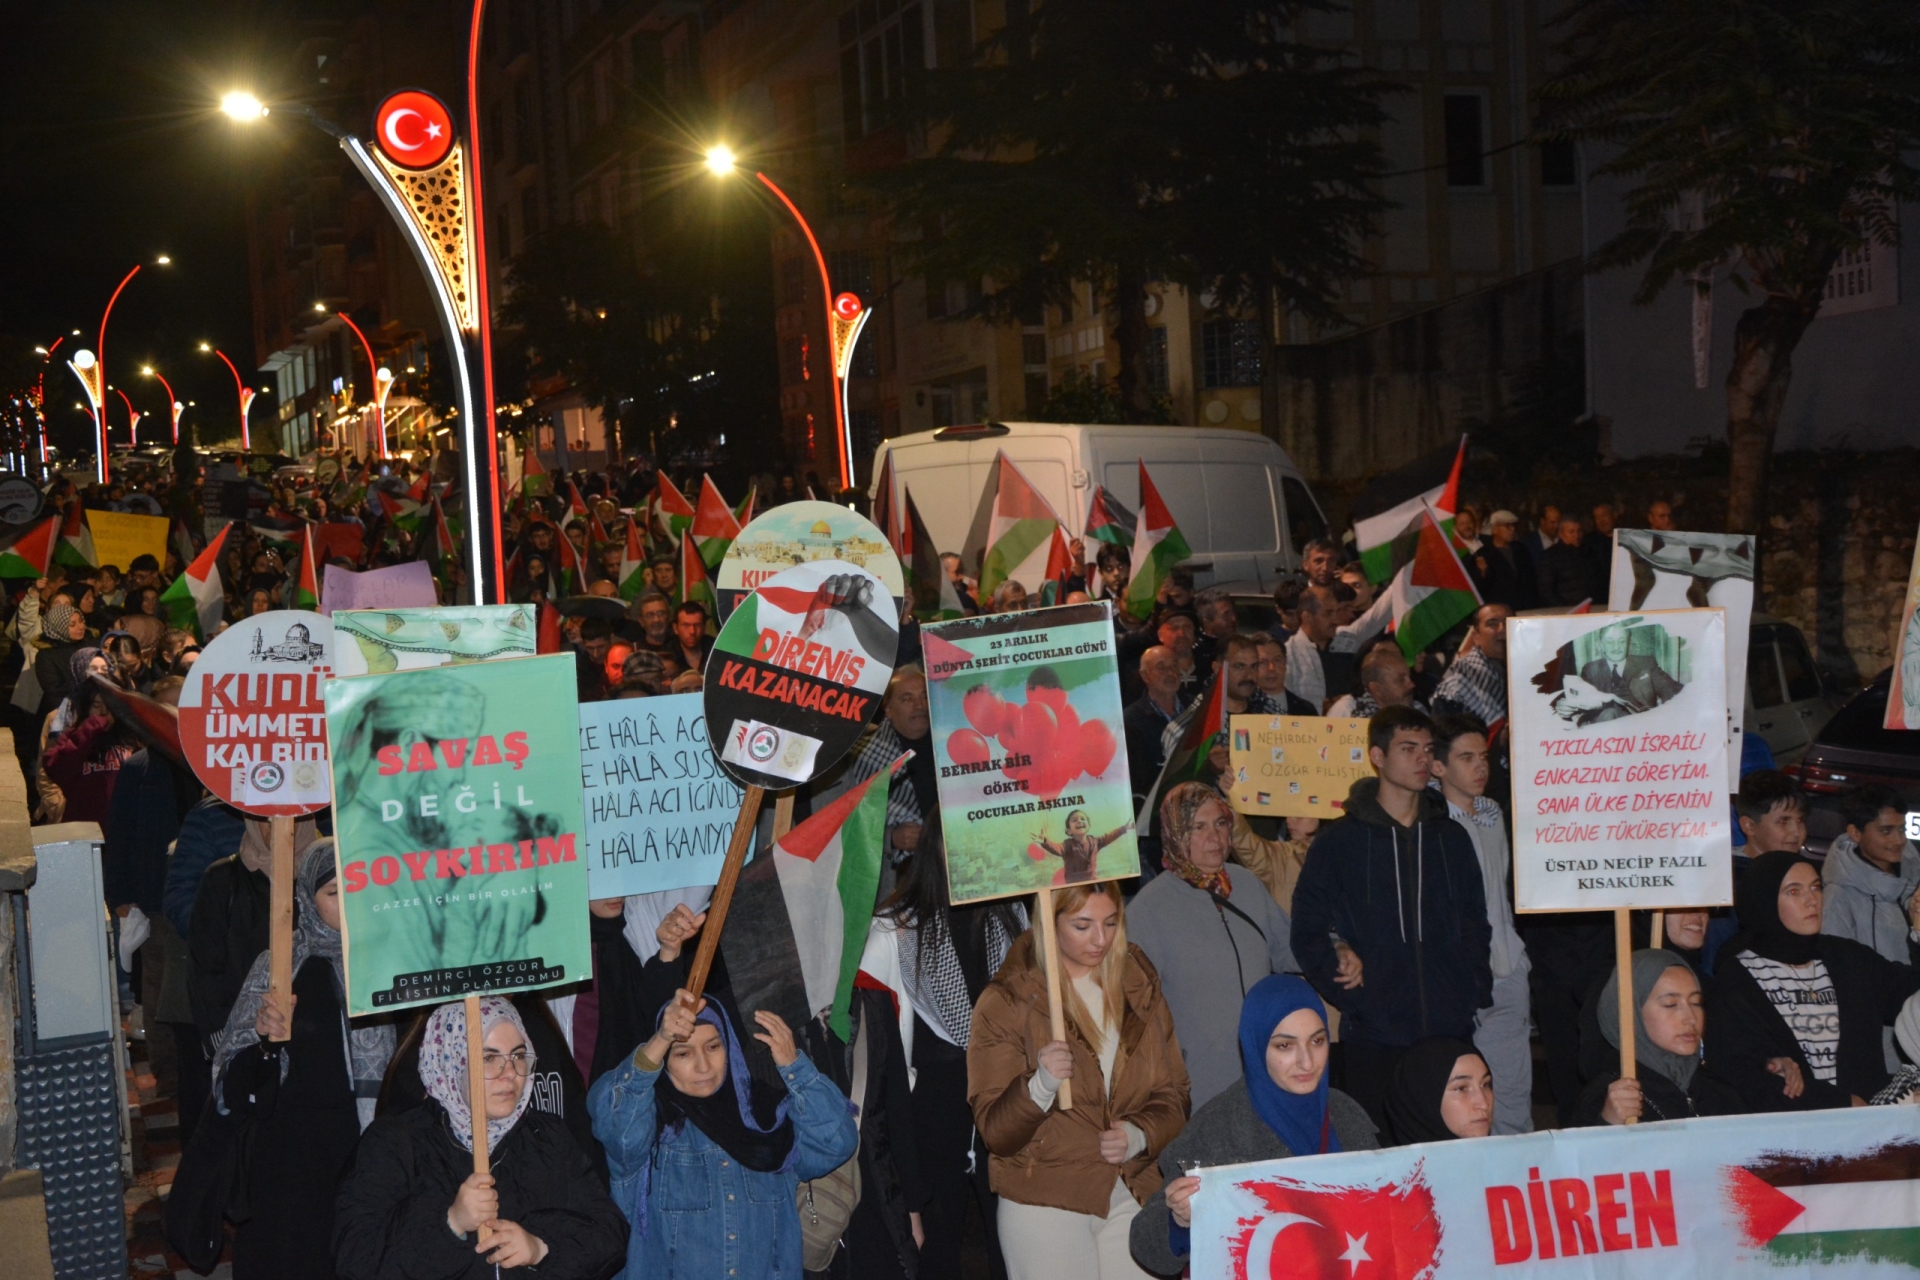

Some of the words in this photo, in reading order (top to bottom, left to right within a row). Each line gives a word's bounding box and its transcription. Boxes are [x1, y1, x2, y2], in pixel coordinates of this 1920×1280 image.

[990, 641, 1003, 650] 23
[1004, 633, 1048, 648] ARALIK
[751, 627, 865, 688] DİRENİŞ
[933, 659, 973, 674] DÜNYA
[976, 653, 1010, 669] ŞEHİT
[1013, 646, 1073, 665] ÇOCUKLAR
[1075, 640, 1108, 654] GÜNÜ
[719, 660, 869, 722] KAZANACAK
[609, 712, 665, 748] HÂLÂ
[1257, 730, 1318, 744] NEHİRDEN
[1638, 730, 1706, 753] İSRAİL!
[376, 731, 530, 776] SAVAŞ
[603, 750, 668, 786] HÂLÂ
[941, 759, 1002, 778] BERRAK
[1005, 752, 1032, 769] BİR
[983, 779, 1029, 796] GÖKTE
[1534, 766, 1623, 786] ENKAZINI
[1625, 760, 1710, 783] GÖREYİM.
[381, 781, 534, 822] DEĞİL
[592, 789, 643, 823] HÂLÂ
[967, 803, 1035, 823] ÇOCUKLAR
[1037, 795, 1085, 811] AŞKINA
[1537, 796, 1580, 815] SANA
[1584, 792, 1629, 813] ÜLKE
[1632, 788, 1713, 811] DİYENİN
[601, 826, 660, 868] HÂLÂ
[1535, 821, 1601, 844] YÜZÜNE
[343, 833, 578, 894] SOYKIRIM
[1545, 858, 1598, 872] ÜSTAD
[1603, 855, 1654, 870] NECİP
[1659, 856, 1706, 868] FAZIL
[373, 898, 420, 912] GAZZE
[429, 893, 460, 905] İÇİN
[469, 890, 492, 901] BİR
[501, 882, 554, 897] OLALIM
[1577, 874, 1675, 890] KISAKÜREK
[378, 983, 451, 1003] FİLİSTİN
[463, 969, 559, 989] PLATFORMU
[400, 969, 472, 987] DEMİRCİ
[483, 961, 539, 975] ÖZGÜR
[1485, 1166, 1679, 1266] DİREN
